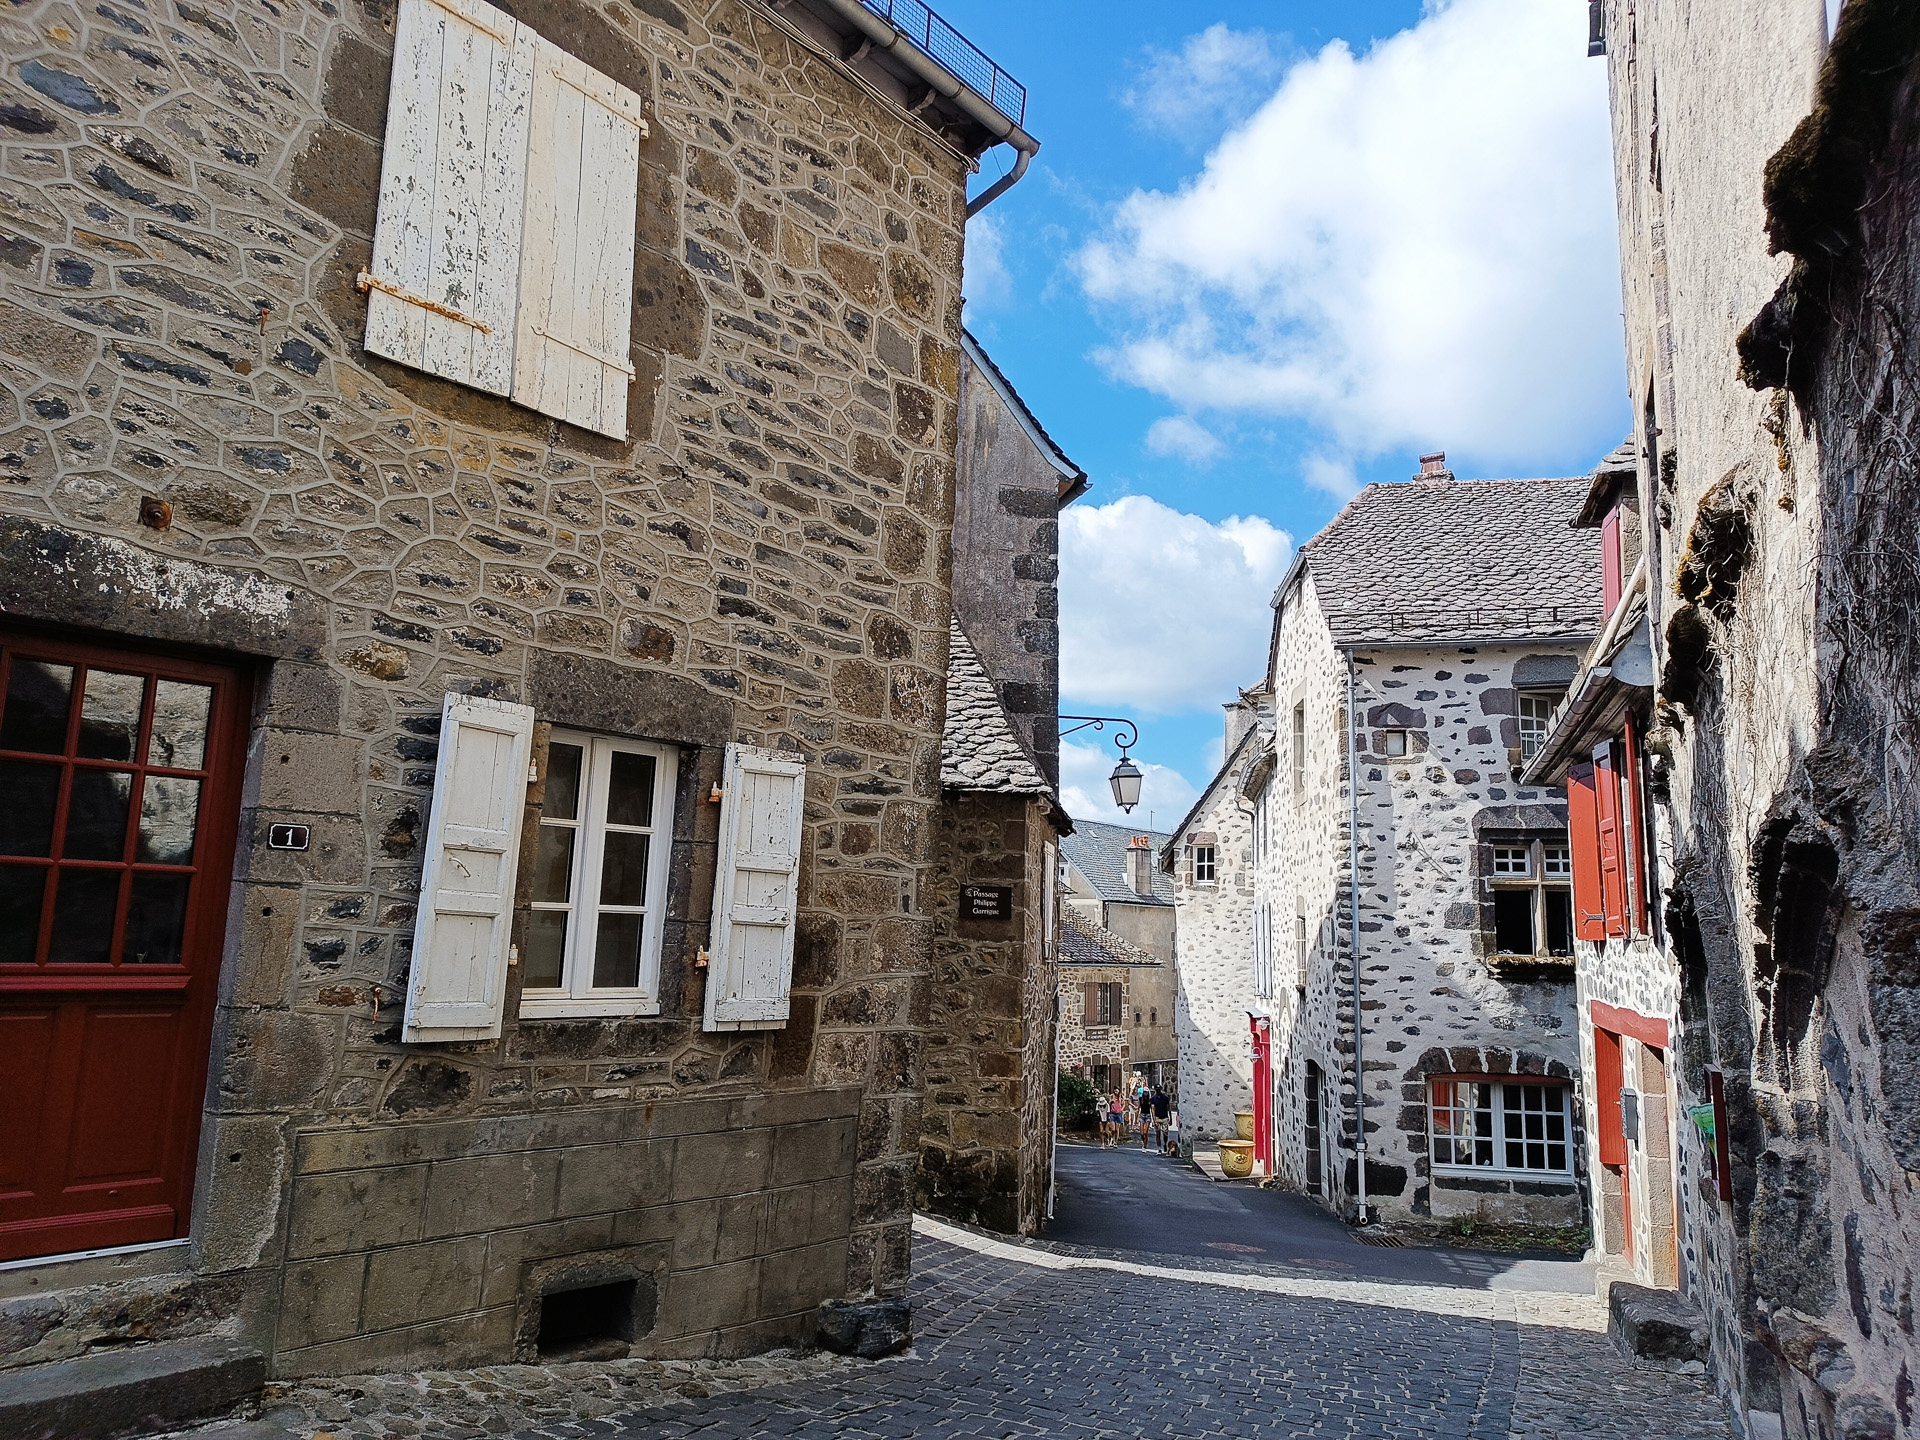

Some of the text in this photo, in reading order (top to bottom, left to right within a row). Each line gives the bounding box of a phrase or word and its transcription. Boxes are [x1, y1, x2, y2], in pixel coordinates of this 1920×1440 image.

[286, 828, 293, 845] 1
[973, 890, 999, 898] Passage
[973, 899, 998, 907] Philippe
